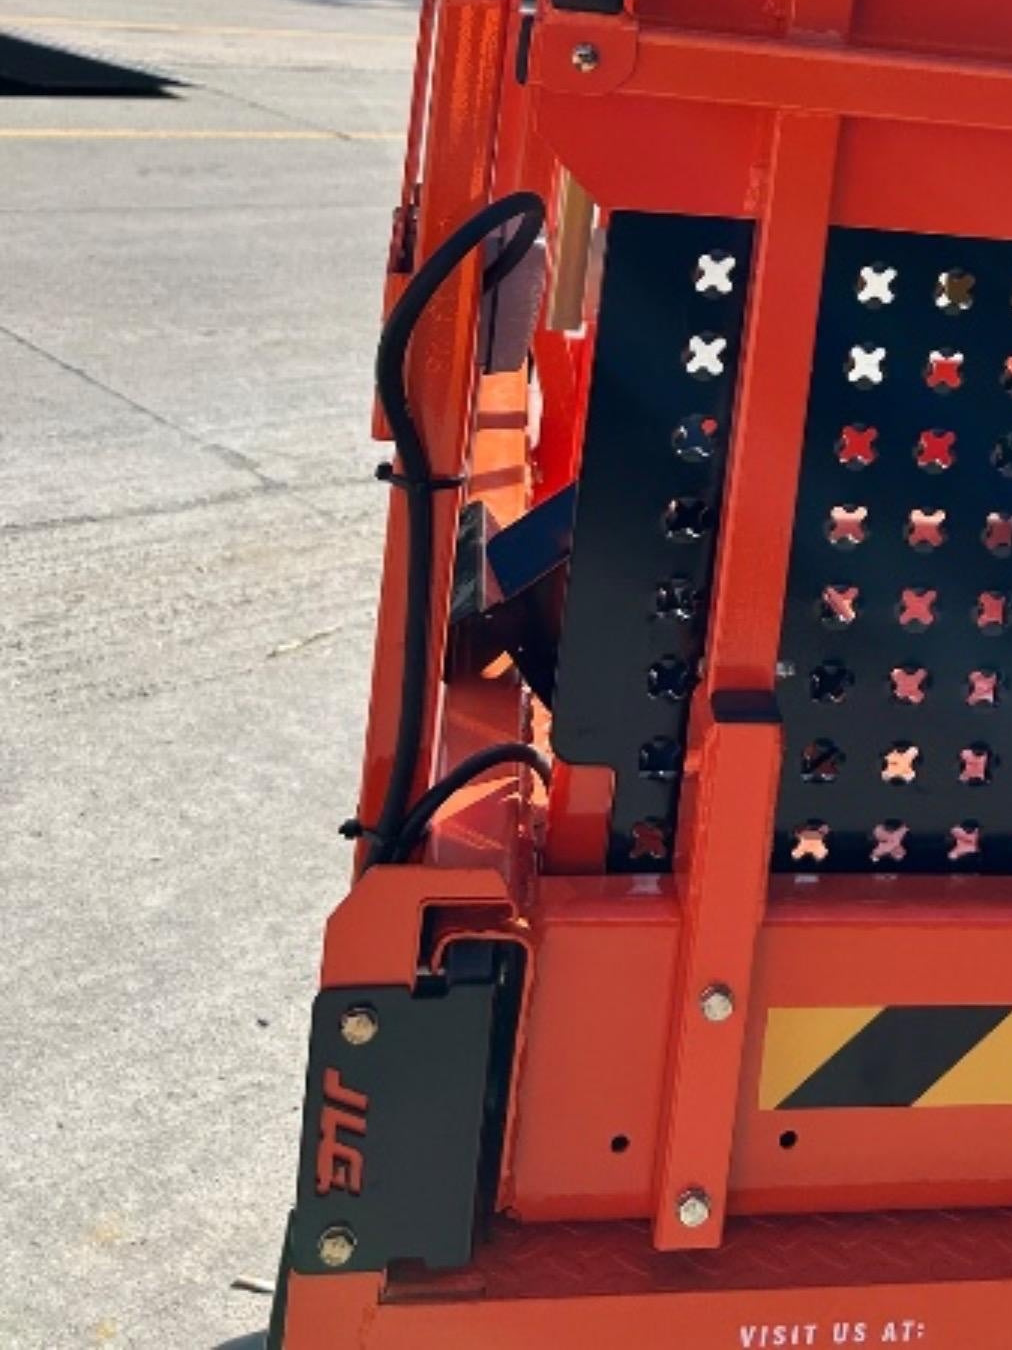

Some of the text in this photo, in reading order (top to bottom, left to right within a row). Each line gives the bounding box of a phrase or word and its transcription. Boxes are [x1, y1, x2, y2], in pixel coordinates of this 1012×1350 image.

[316, 1066, 369, 1195] JLG
[740, 1319, 926, 1348] VISIT US AT:
